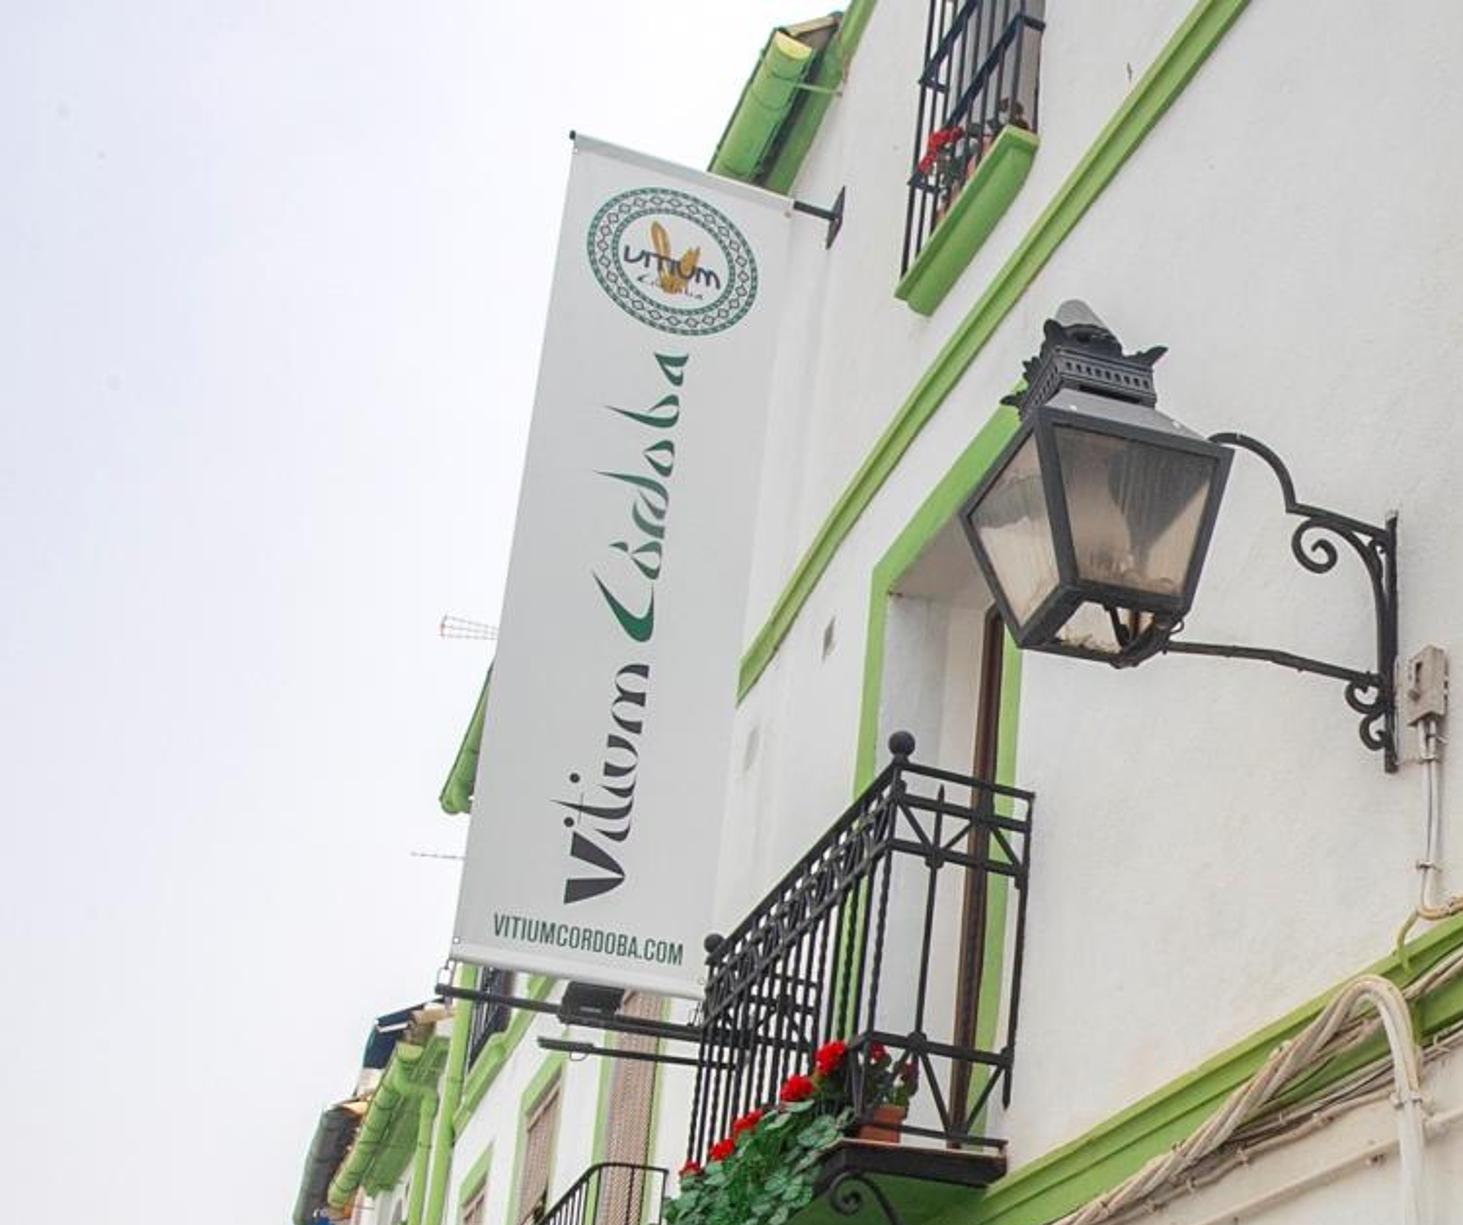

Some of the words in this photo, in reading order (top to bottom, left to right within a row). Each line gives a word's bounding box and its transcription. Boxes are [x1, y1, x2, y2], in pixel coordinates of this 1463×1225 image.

[590, 352, 689, 642] Córdoba
[551, 663, 651, 904] Vitium
[494, 912, 684, 966] VITIUMCORDOBA.COM
